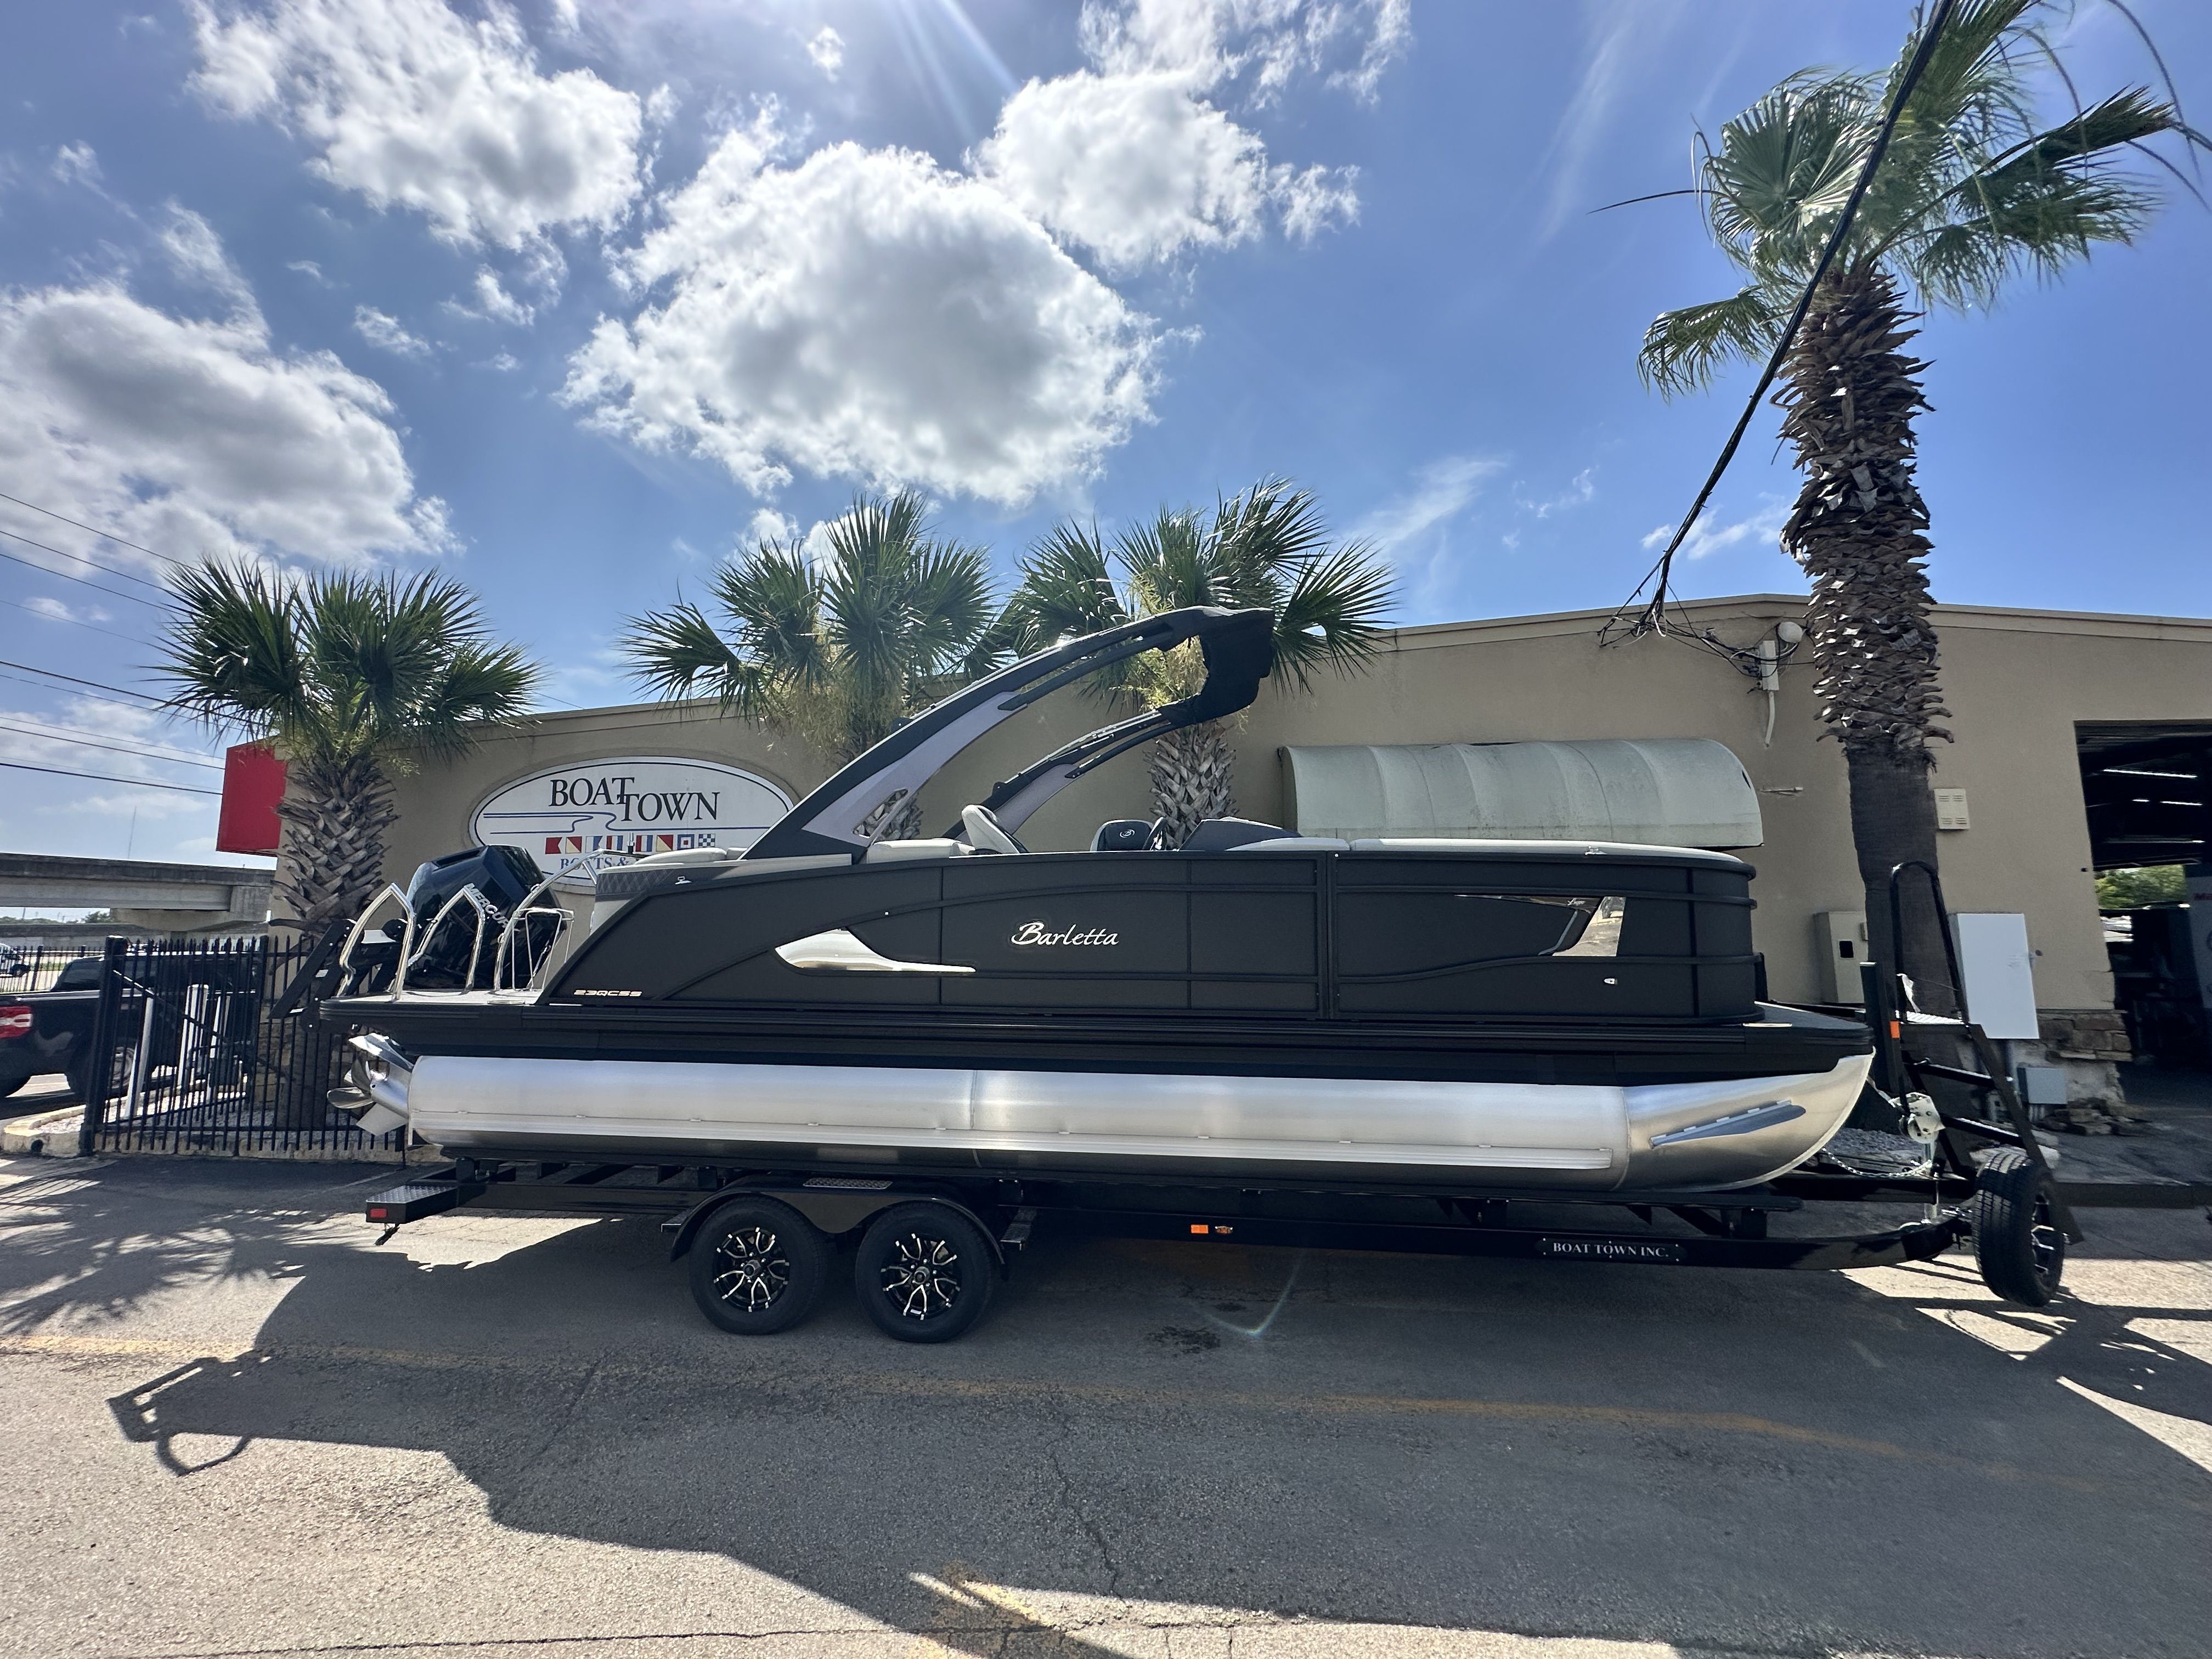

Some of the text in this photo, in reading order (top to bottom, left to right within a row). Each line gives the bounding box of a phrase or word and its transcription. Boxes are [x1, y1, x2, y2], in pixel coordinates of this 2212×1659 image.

[549, 777, 720, 821] BOAT TOWN
[464, 883, 520, 932] MERCUR
[1011, 922, 1119, 945] Barletta
[1553, 1243, 1669, 1257] BOAT TOWN INC.
